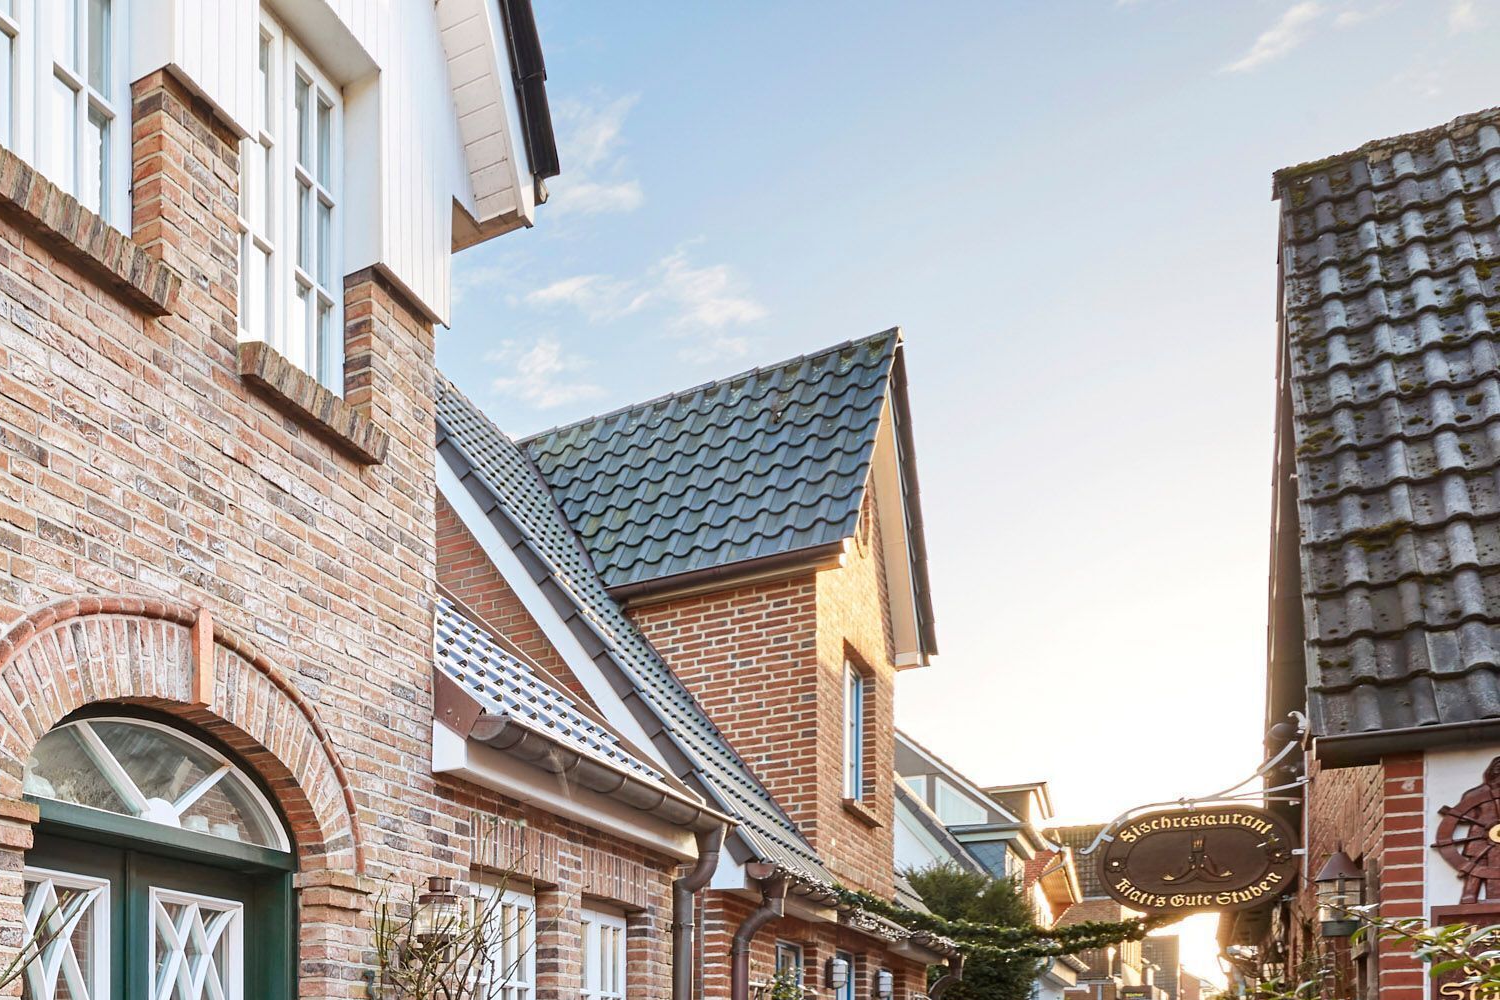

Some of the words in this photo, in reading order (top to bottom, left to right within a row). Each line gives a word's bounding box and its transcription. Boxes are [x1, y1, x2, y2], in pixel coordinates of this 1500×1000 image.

[1119, 813, 1274, 843] Fischrestaurant
[1114, 877, 1166, 907] Klatt's
[1169, 893, 1212, 907] Gute
[1215, 871, 1282, 905] Stuben
